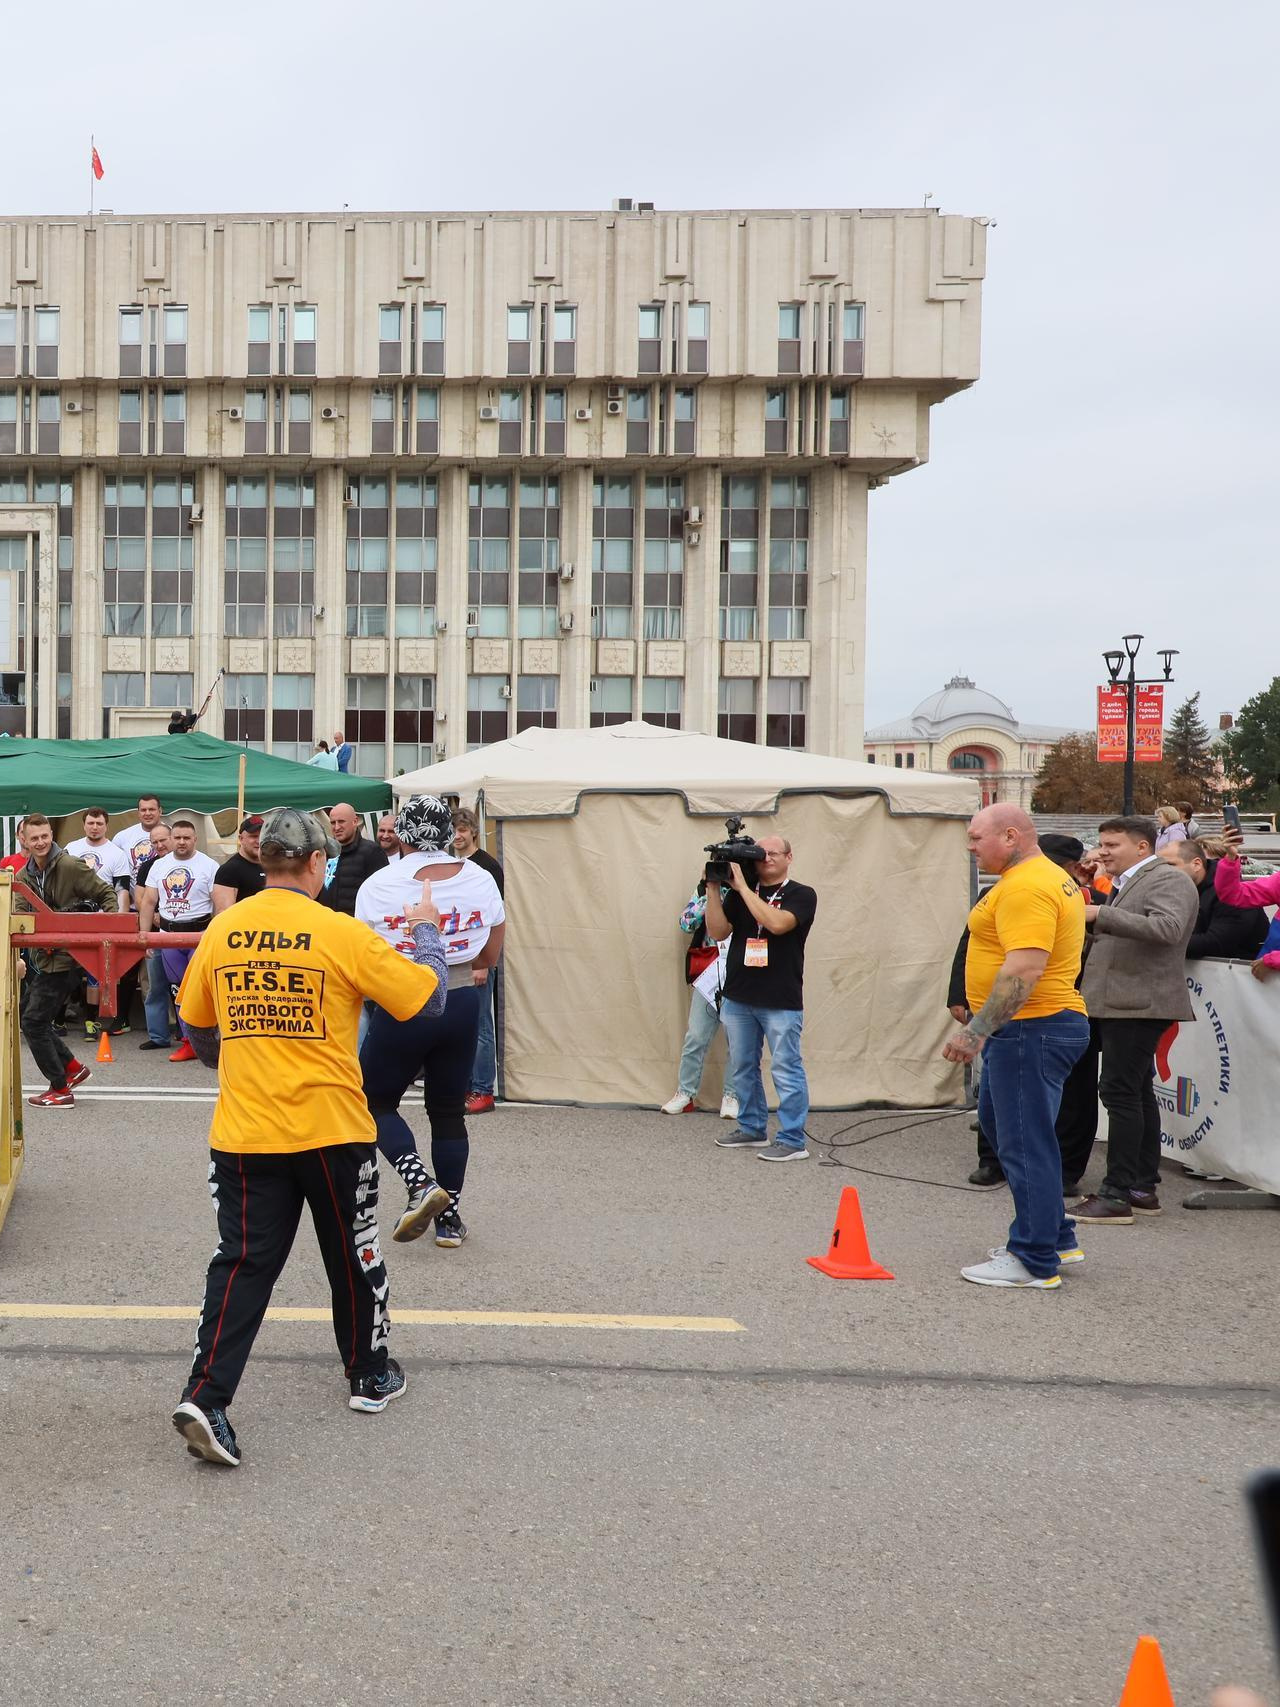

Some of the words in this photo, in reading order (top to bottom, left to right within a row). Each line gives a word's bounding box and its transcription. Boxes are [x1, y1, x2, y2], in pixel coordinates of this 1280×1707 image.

[227, 930, 312, 952] СУДЬЯ
[224, 971, 314, 994] T.F.S.E.
[227, 995, 259, 1003] Тульская
[263, 994, 313, 1004] федерация
[227, 1004, 314, 1018] СИЛОВОГО
[229, 1018, 315, 1033] ЭКСТРИМА
[1204, 1001, 1231, 1094] АТЛЕТИКИ
[1178, 1116, 1214, 1151] ОБЛАСТИ
